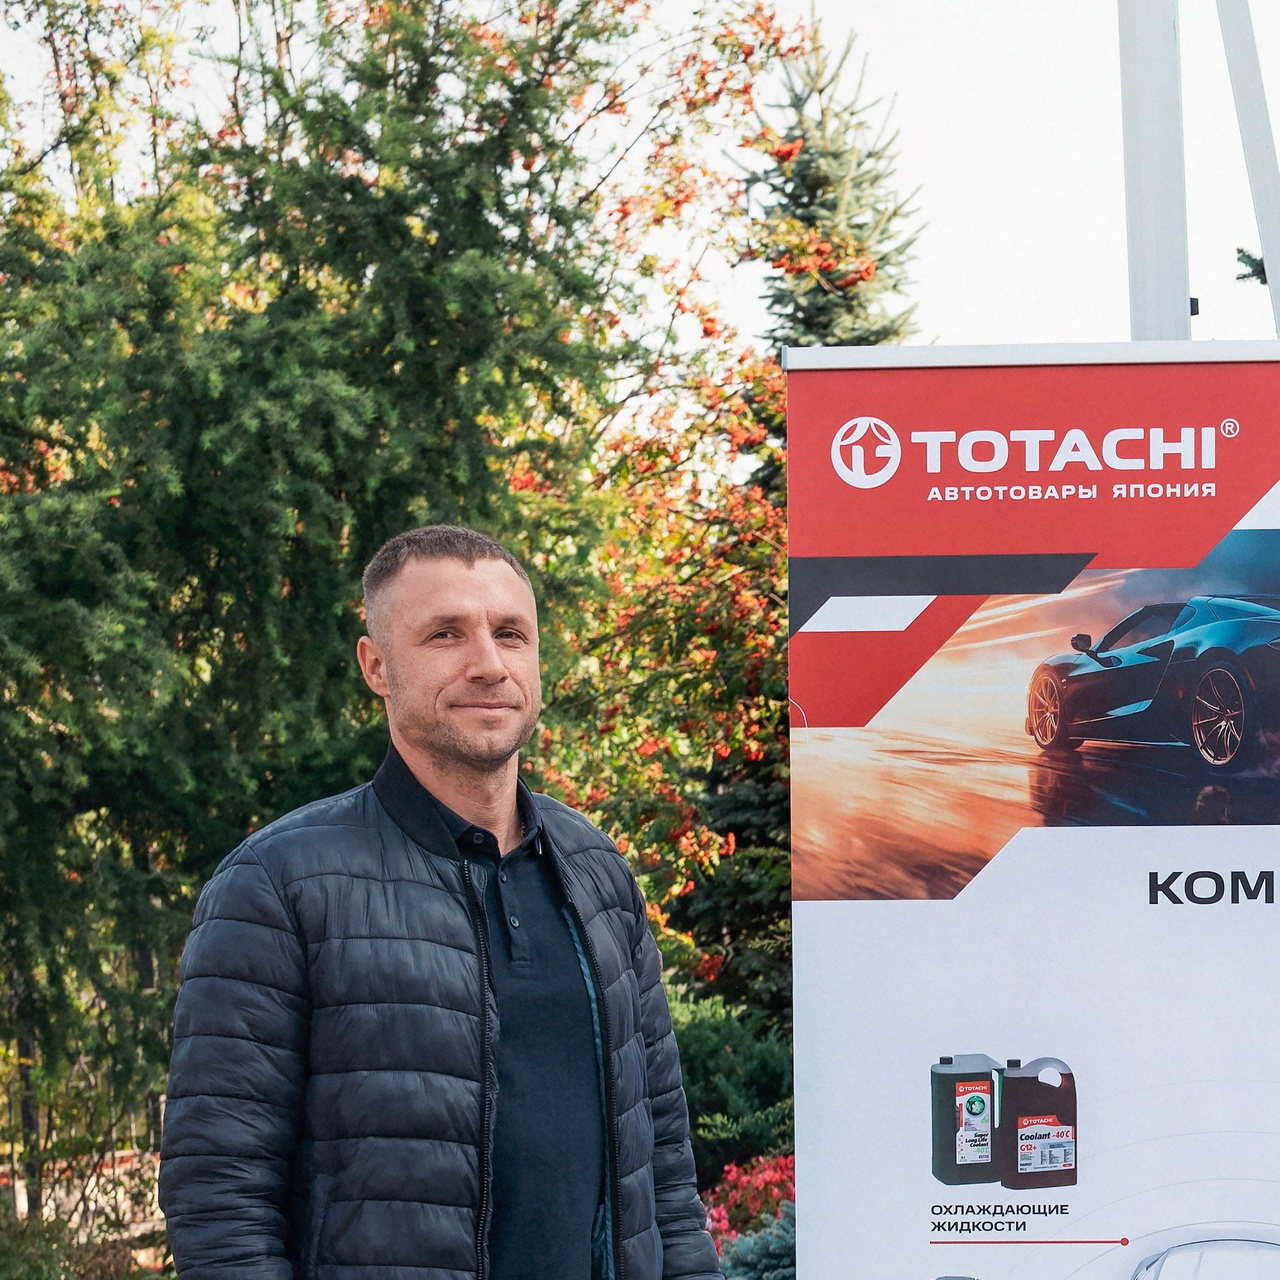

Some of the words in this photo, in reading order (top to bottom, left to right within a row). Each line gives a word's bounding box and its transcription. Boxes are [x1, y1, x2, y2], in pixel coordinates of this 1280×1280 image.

[927, 484, 1098, 502] АВТОТОВАРЫ
[1112, 482, 1217, 499] ЯПОНИЯ
[1020, 1132, 1051, 1141] Coolant
[1020, 1144, 1037, 1152] G12+
[930, 1204, 1070, 1217] ОХЛАЖДАЮЩИЕ
[930, 1221, 1027, 1234] ЖИДКОСТИ
